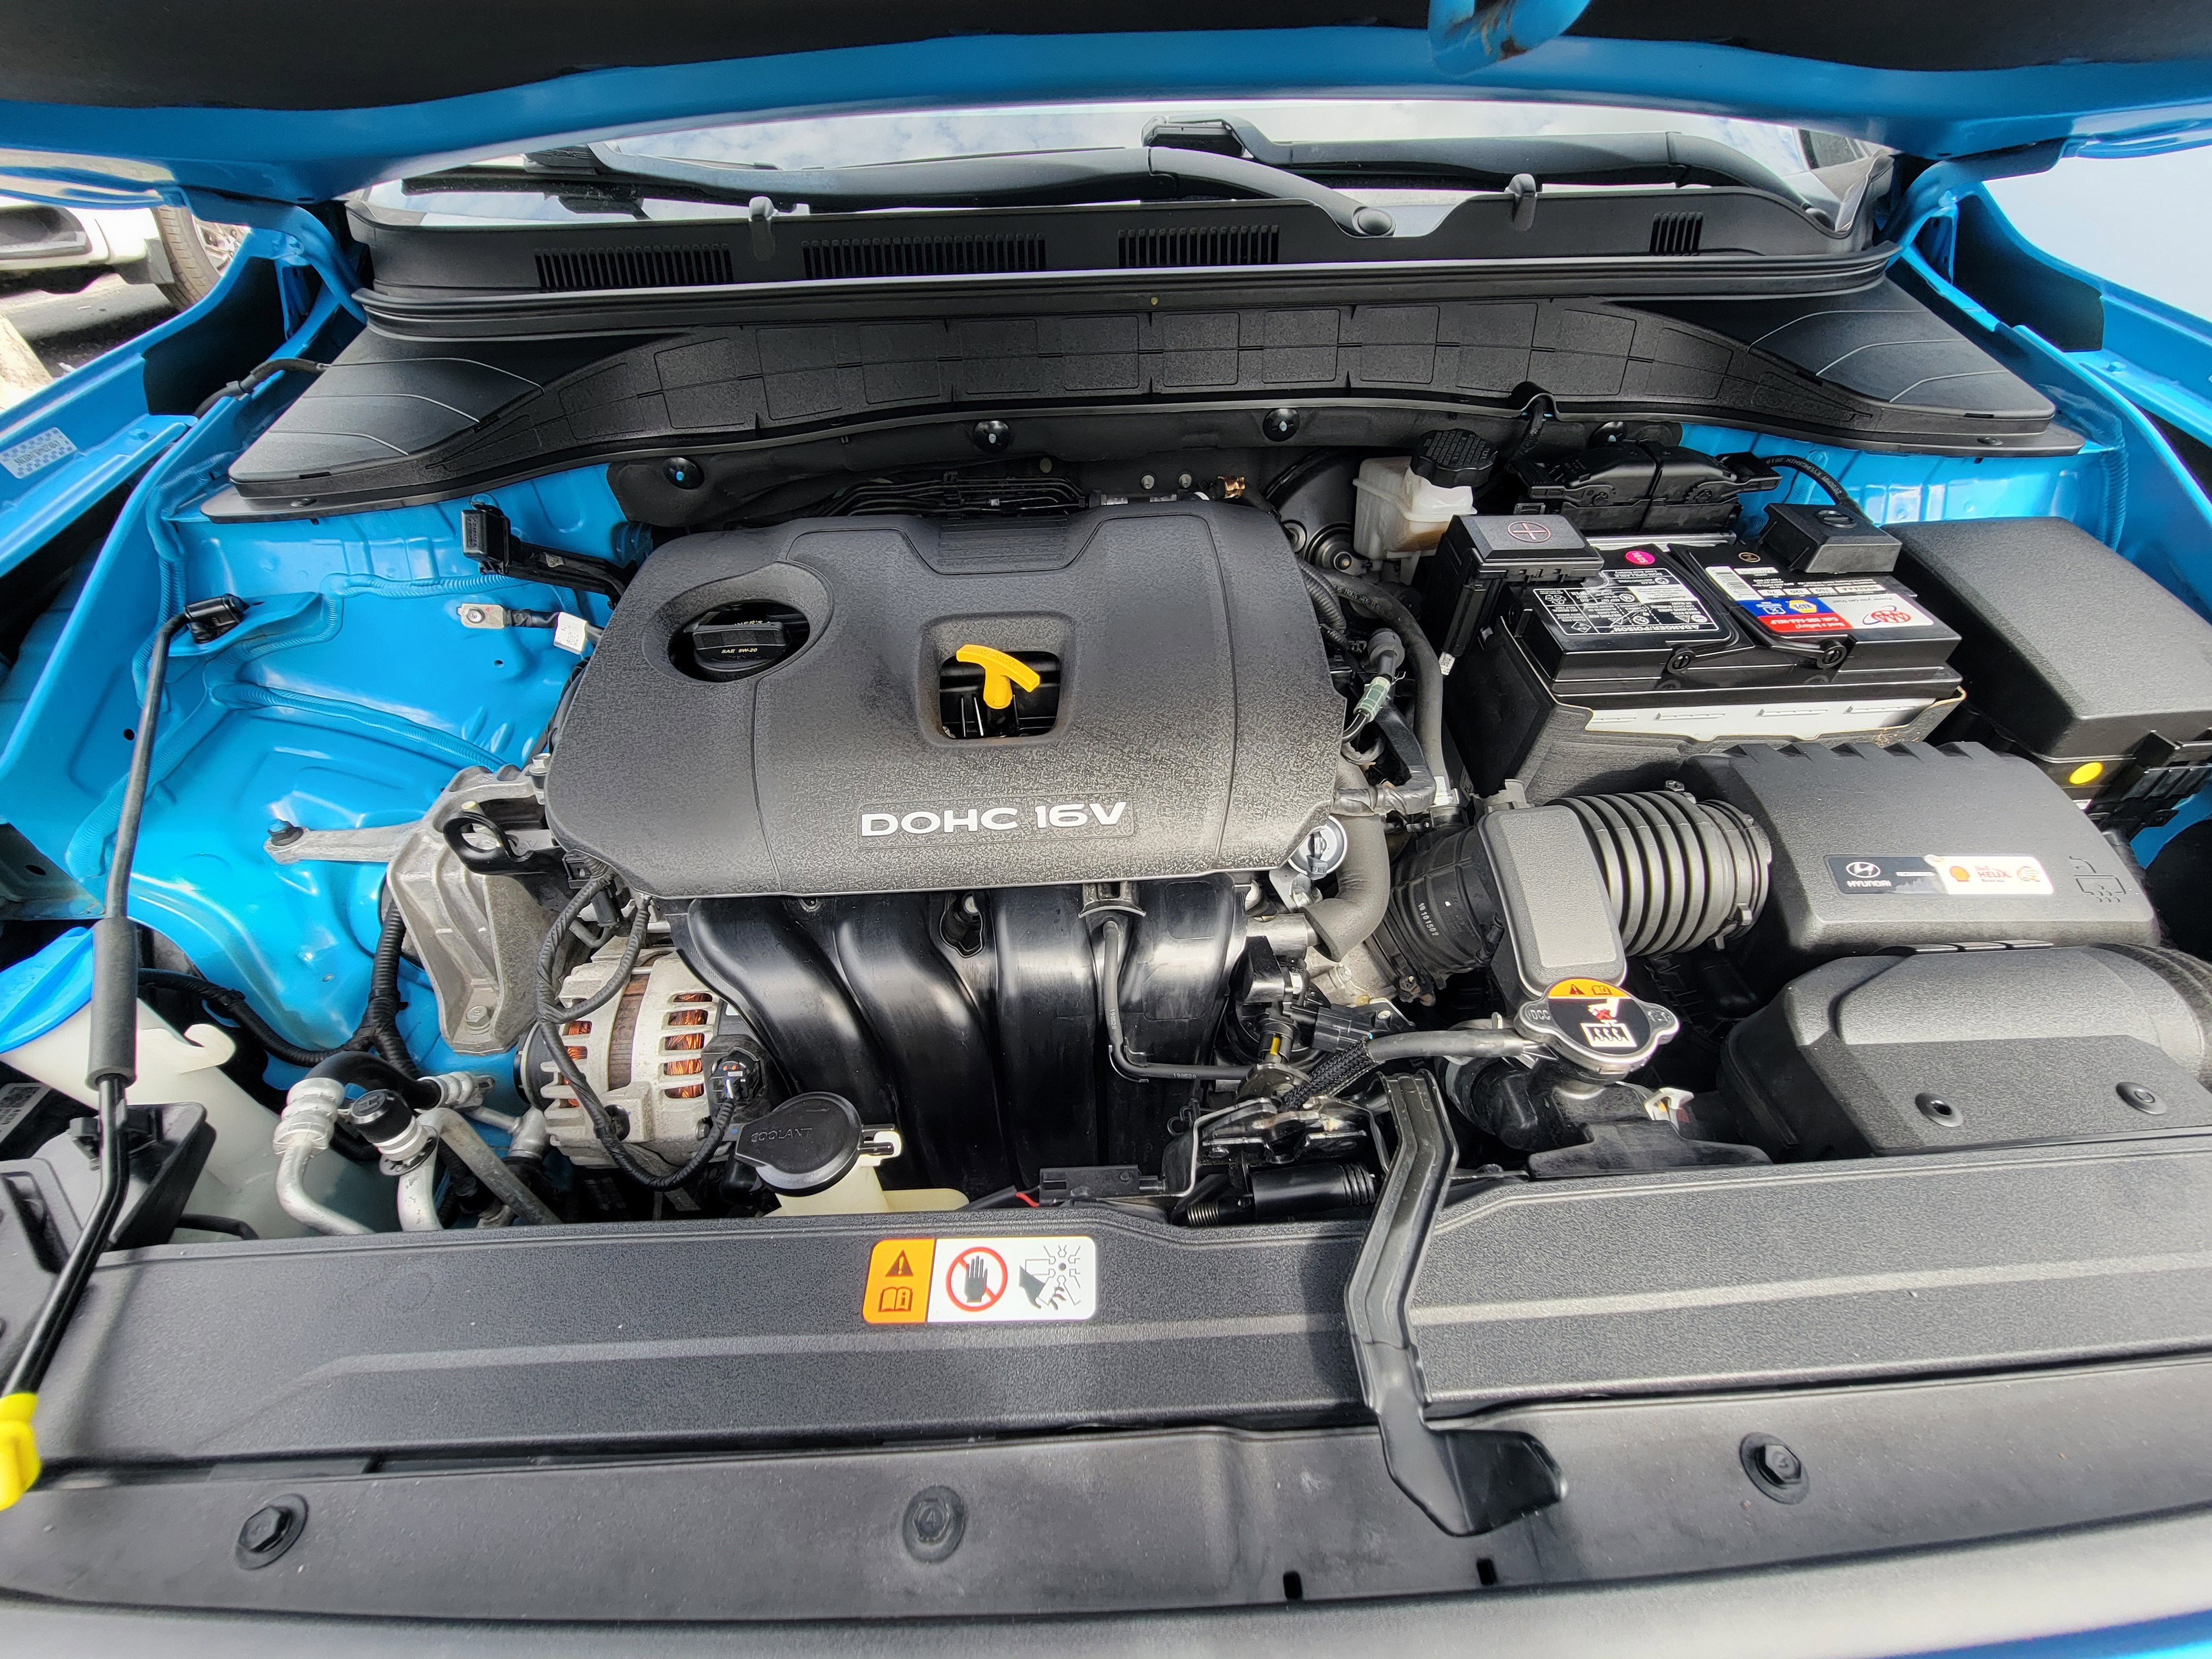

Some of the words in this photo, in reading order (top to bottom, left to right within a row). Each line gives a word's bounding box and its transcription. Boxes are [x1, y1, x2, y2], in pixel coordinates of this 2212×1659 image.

[861, 806, 1018, 837] DOHC
[1034, 801, 1127, 829] 16V
[750, 1127, 813, 1142] COOLANT
